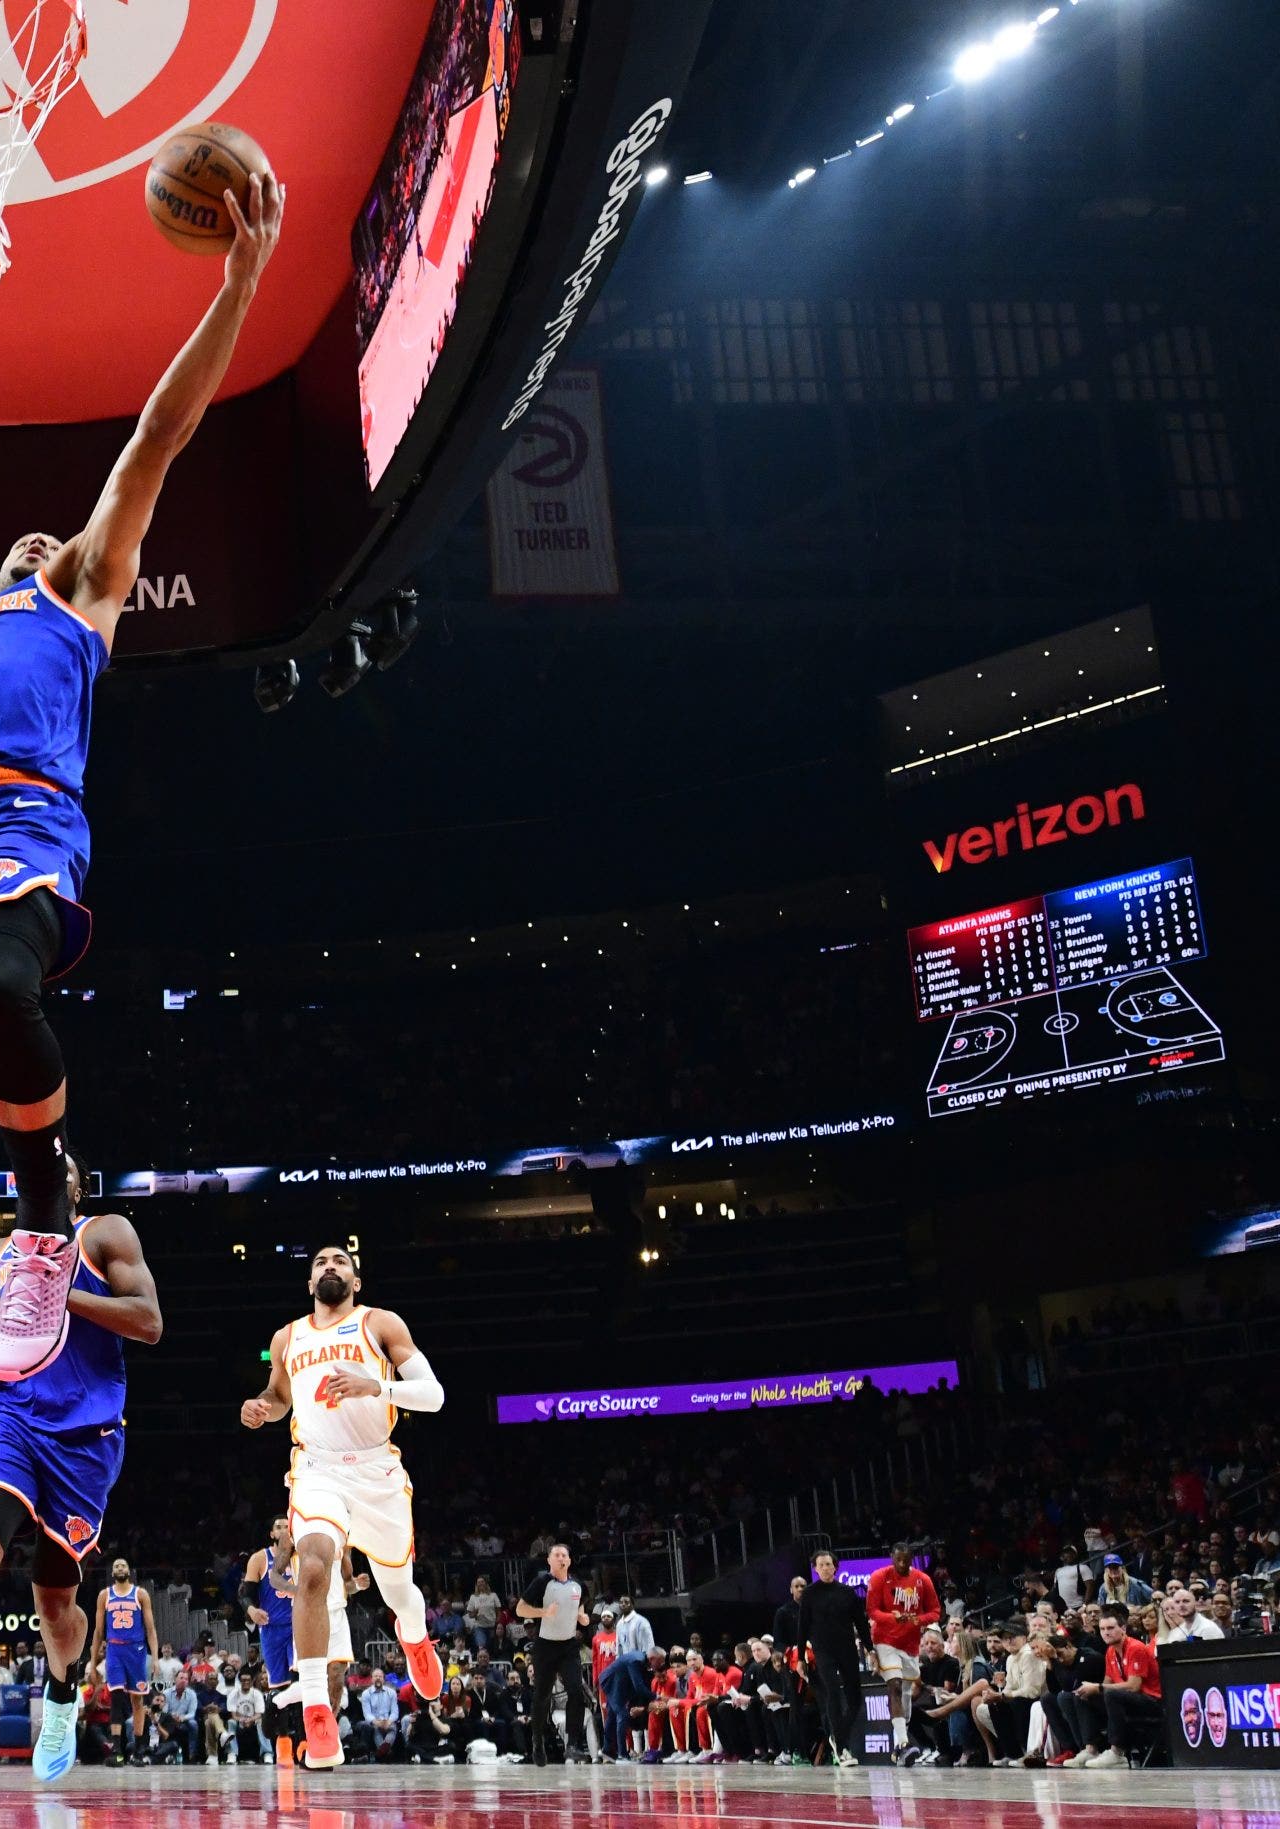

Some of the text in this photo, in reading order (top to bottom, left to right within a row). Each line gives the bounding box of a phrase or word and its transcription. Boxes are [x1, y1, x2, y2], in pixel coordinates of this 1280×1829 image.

[531, 502, 568, 524] TED
[514, 528, 590, 550] TURNER
[922, 783, 1144, 873] verizon
[1074, 870, 1161, 900] NEW YORK KNICKS
[939, 909, 1012, 935] ATLANTA HAWKS
[1063, 912, 1092, 926] Towns
[1065, 925, 1085, 937] Hart
[1066, 933, 1104, 948] Brunson
[924, 946, 956, 960] Vincent
[1068, 944, 1108, 960] Anunoby
[1070, 956, 1103, 971] Bridges
[927, 968, 960, 983] Johnson
[928, 978, 959, 992] Daniels
[947, 1091, 985, 1108] CLOSED
[986, 1087, 1006, 1101] CAP
[1014, 1077, 1050, 1094] ONING
[1112, 1063, 1127, 1075] BY
[720, 1135, 742, 1146] The
[746, 1131, 786, 1144] all-new
[789, 1126, 808, 1139] Kia
[810, 1120, 859, 1136] Telluride
[862, 1116, 894, 1129] X-Pro
[326, 1169, 346, 1180] The
[349, 1167, 387, 1180] all-new
[390, 1166, 406, 1177] Kia
[408, 1162, 454, 1176] Telluride
[456, 1160, 486, 1172] X-Pro
[291, 1344, 364, 1376] ATLANTA
[558, 1394, 660, 1414] CareSource
[691, 1392, 719, 1404] Caring
[720, 1392, 732, 1402] for
[734, 1390, 746, 1401] the
[751, 1384, 786, 1403] Whole
[790, 1376, 832, 1401] Health
[833, 1382, 842, 1392] of
[112, 1610, 134, 1629] 25
